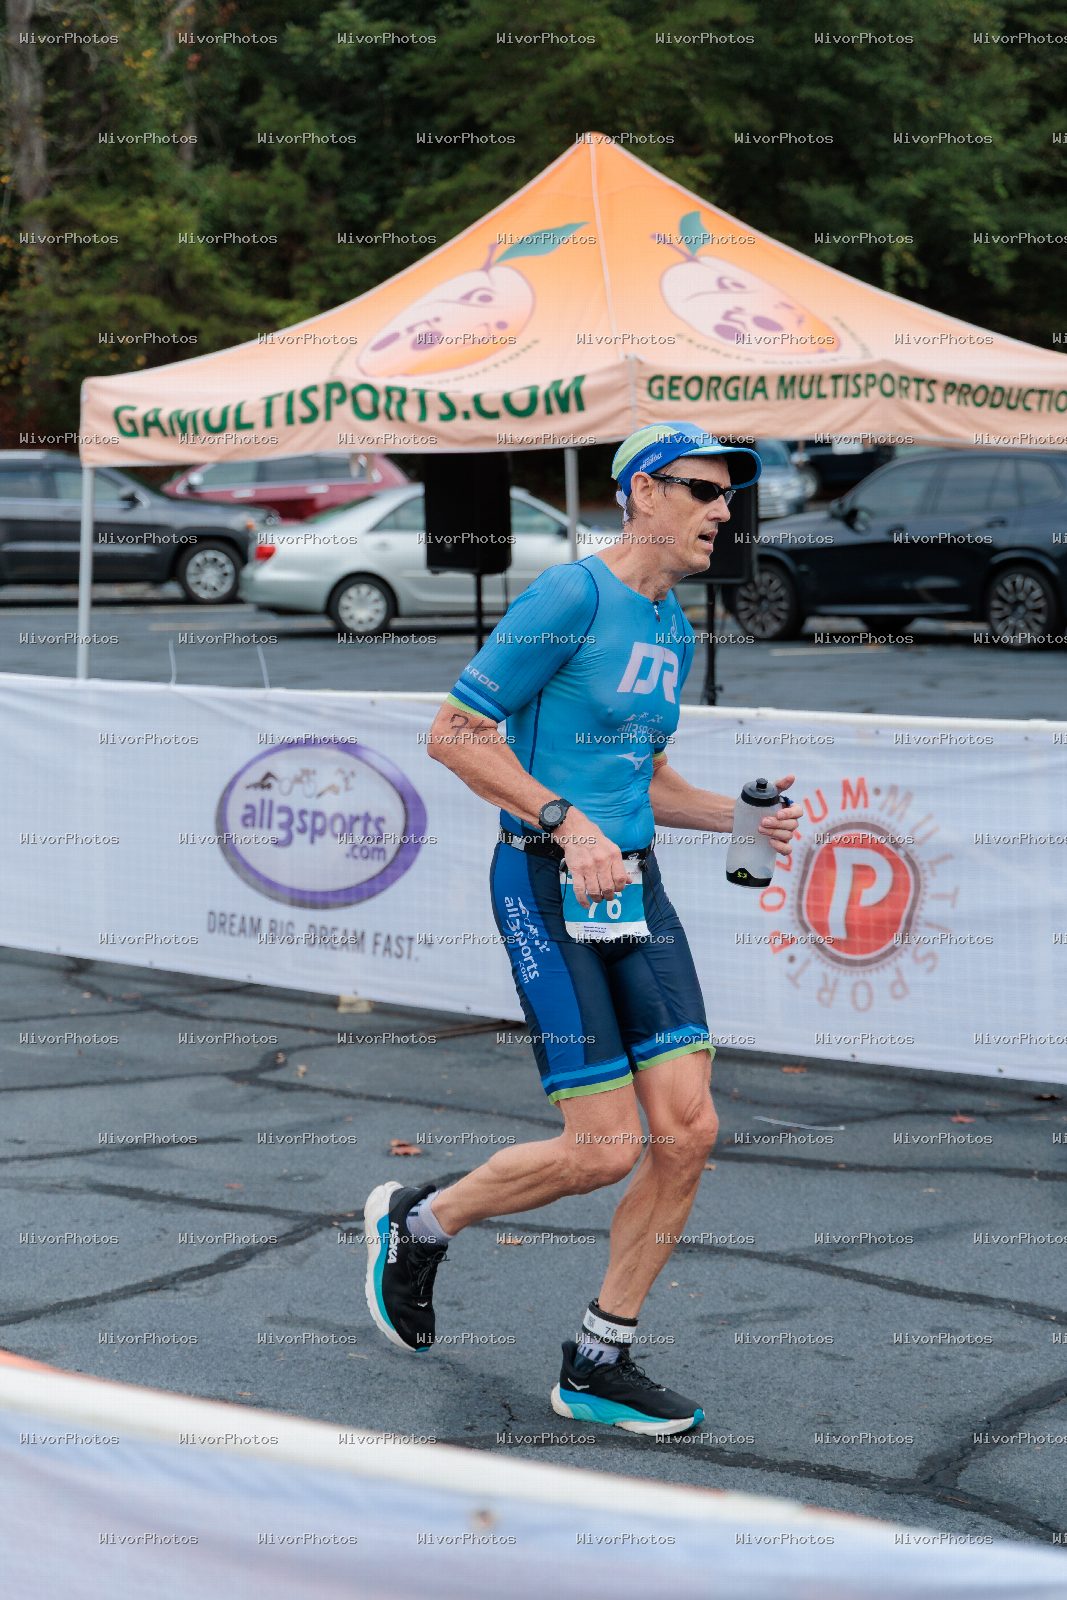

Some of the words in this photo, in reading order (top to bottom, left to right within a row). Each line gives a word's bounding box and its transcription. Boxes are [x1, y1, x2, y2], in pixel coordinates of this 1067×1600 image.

[113, 374, 587, 437] GAMULTISPORTS.COM
[648, 374, 769, 401] GEORGIA
[776, 373, 938, 403] MULTISPORTS
[240, 798, 387, 848] all3sports
[206, 910, 262, 940] DREAM
[503, 896, 540, 980] all3sports
[604, 1326, 619, 1338] 76
